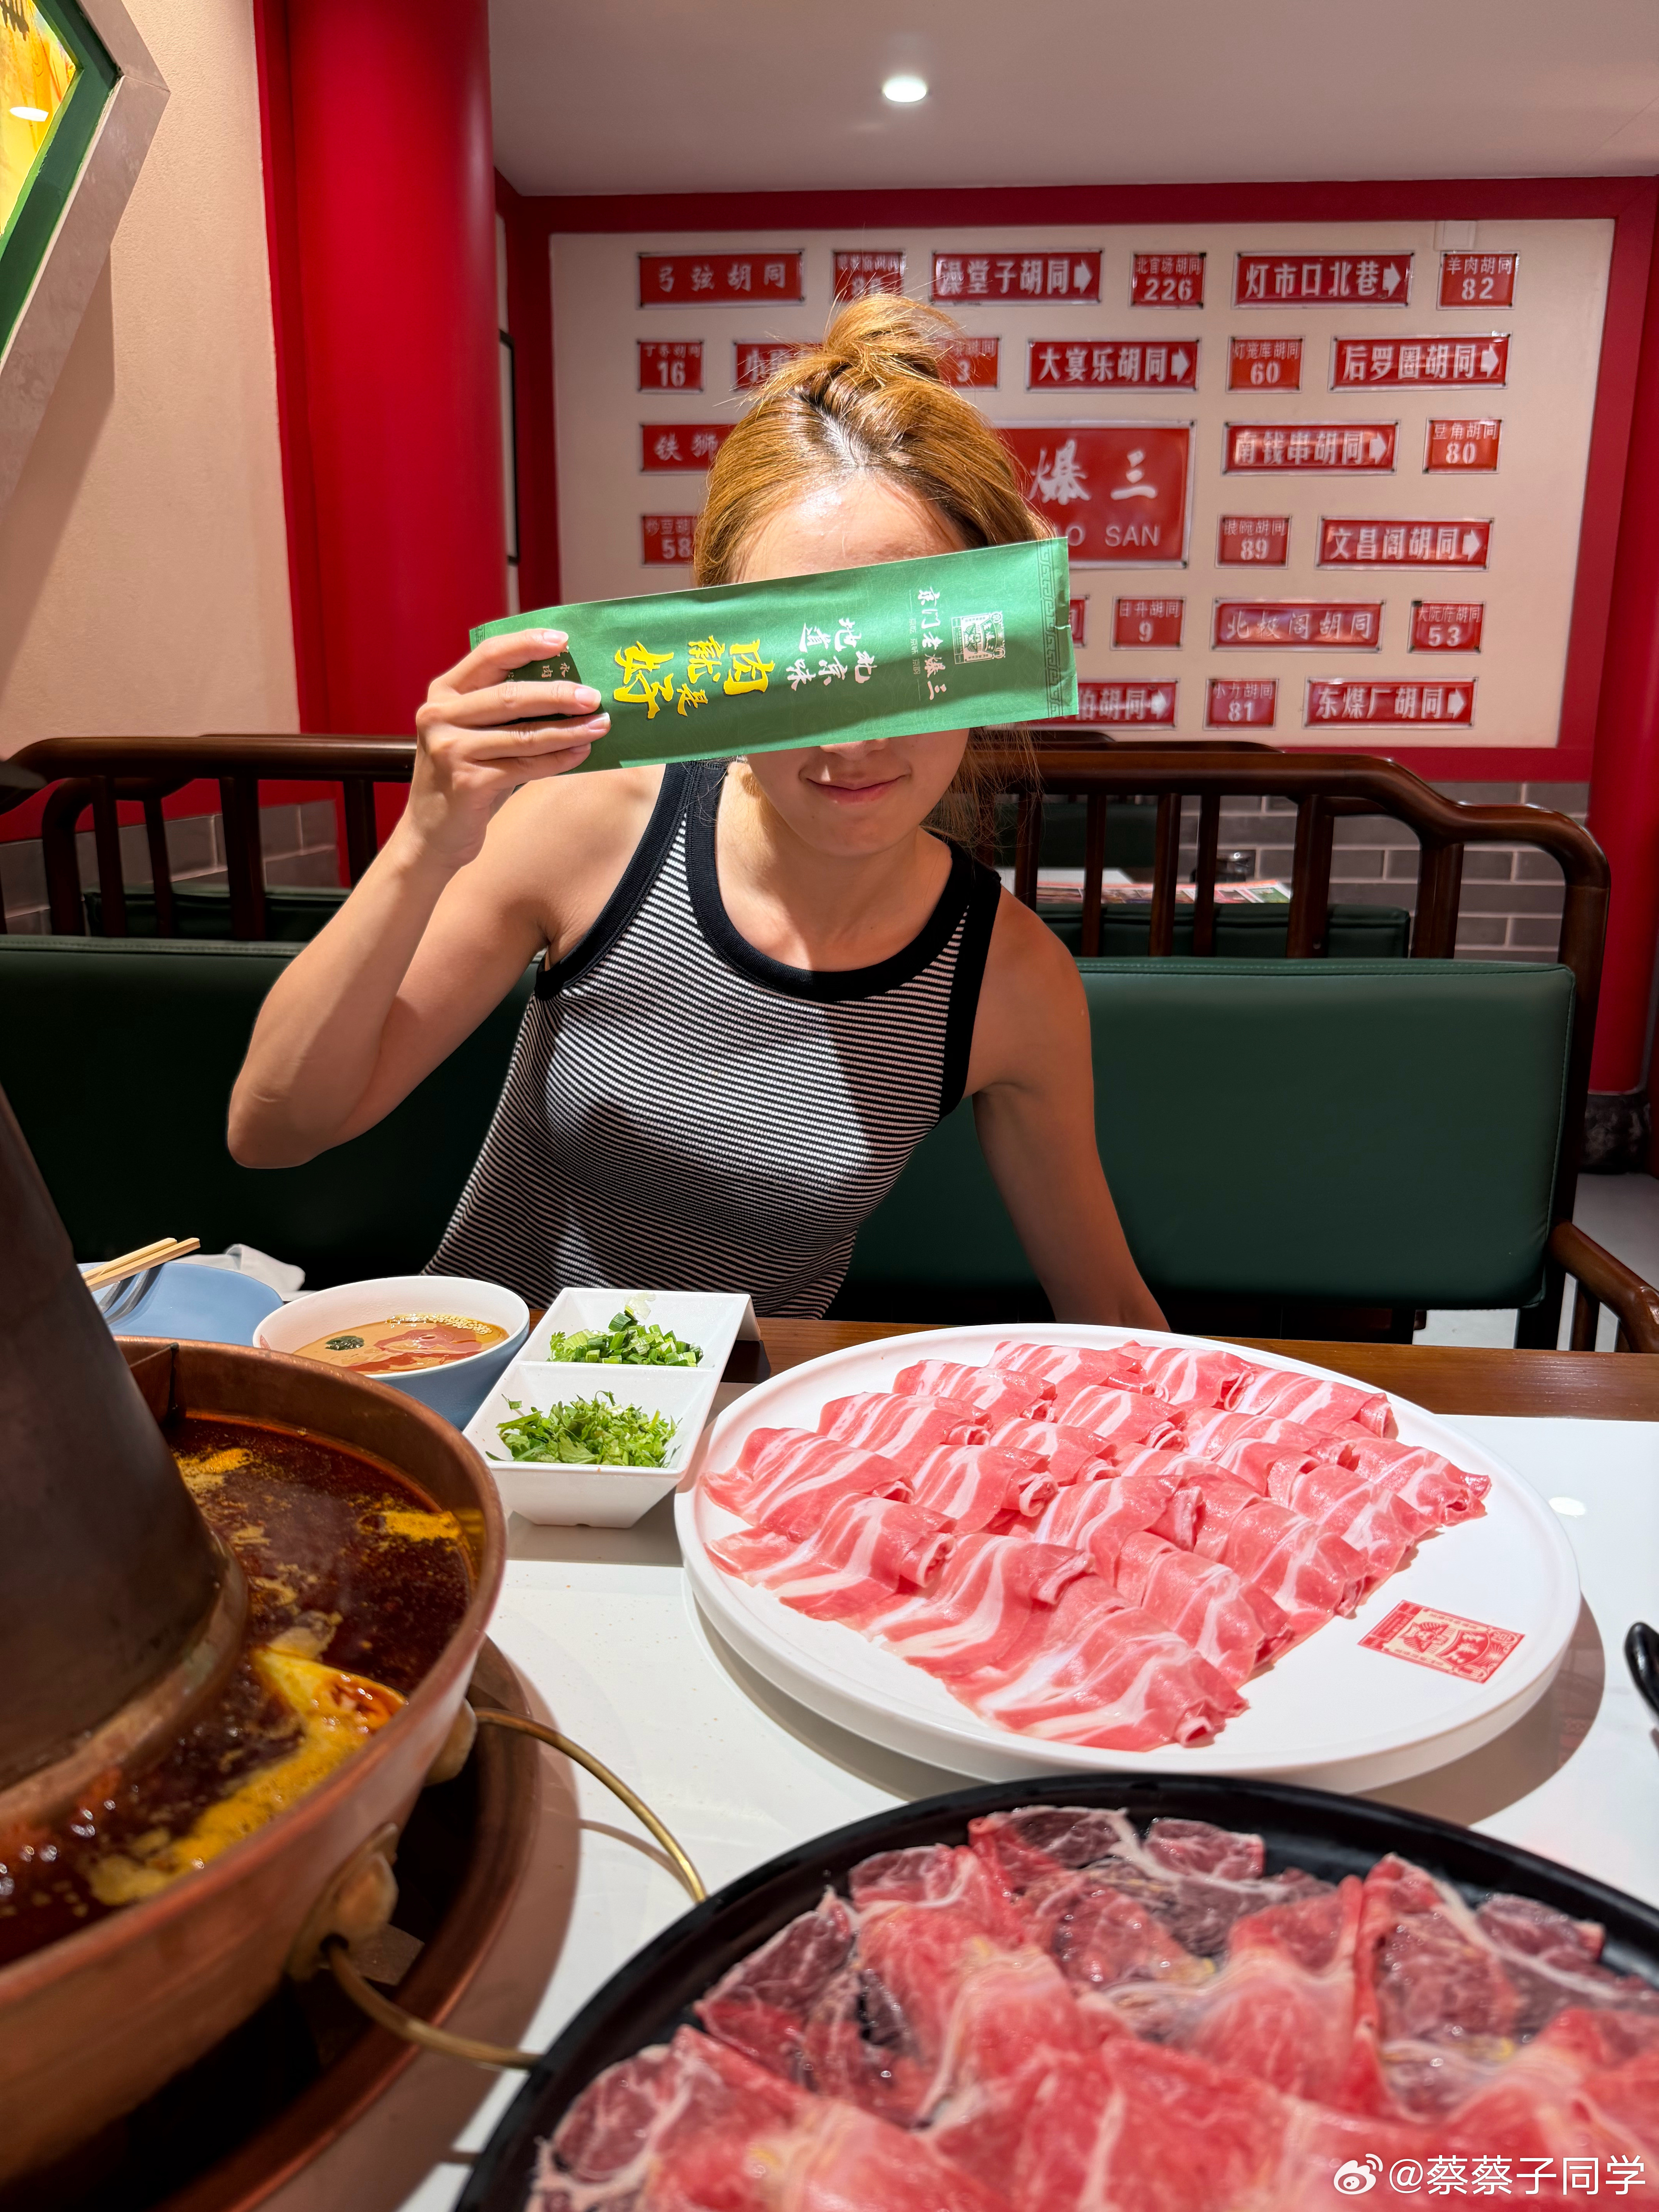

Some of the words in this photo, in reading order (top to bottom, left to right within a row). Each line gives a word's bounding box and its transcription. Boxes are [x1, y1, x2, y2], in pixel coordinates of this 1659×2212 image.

[659, 262, 786, 292] 弓弦胡同
[1447, 257, 1512, 275] 羊肉胡同
[1142, 278, 1192, 301] 226
[1245, 260, 1379, 299] 灯市口北巷
[1462, 278, 1494, 301] 82
[658, 361, 685, 387] 16
[1039, 347, 1167, 382] 大宴乐胡同
[1250, 362, 1280, 385] 60
[1343, 345, 1475, 381] 后罗圈胡同
[1433, 422, 1498, 440] 豆角胡同
[1446, 442, 1477, 464] 80
[1105, 524, 1159, 546] SAN
[1329, 527, 1458, 560] 文昌阁胡同
[662, 538, 691, 560] 58
[1241, 538, 1269, 560] 89
[799, 618, 862, 653] 地道
[1139, 621, 1154, 642] 9
[1428, 626, 1462, 646] 53
[786, 651, 878, 691] 北京味
[1228, 701, 1255, 721] 81
[1316, 686, 1444, 719] 东煤厂胡同
